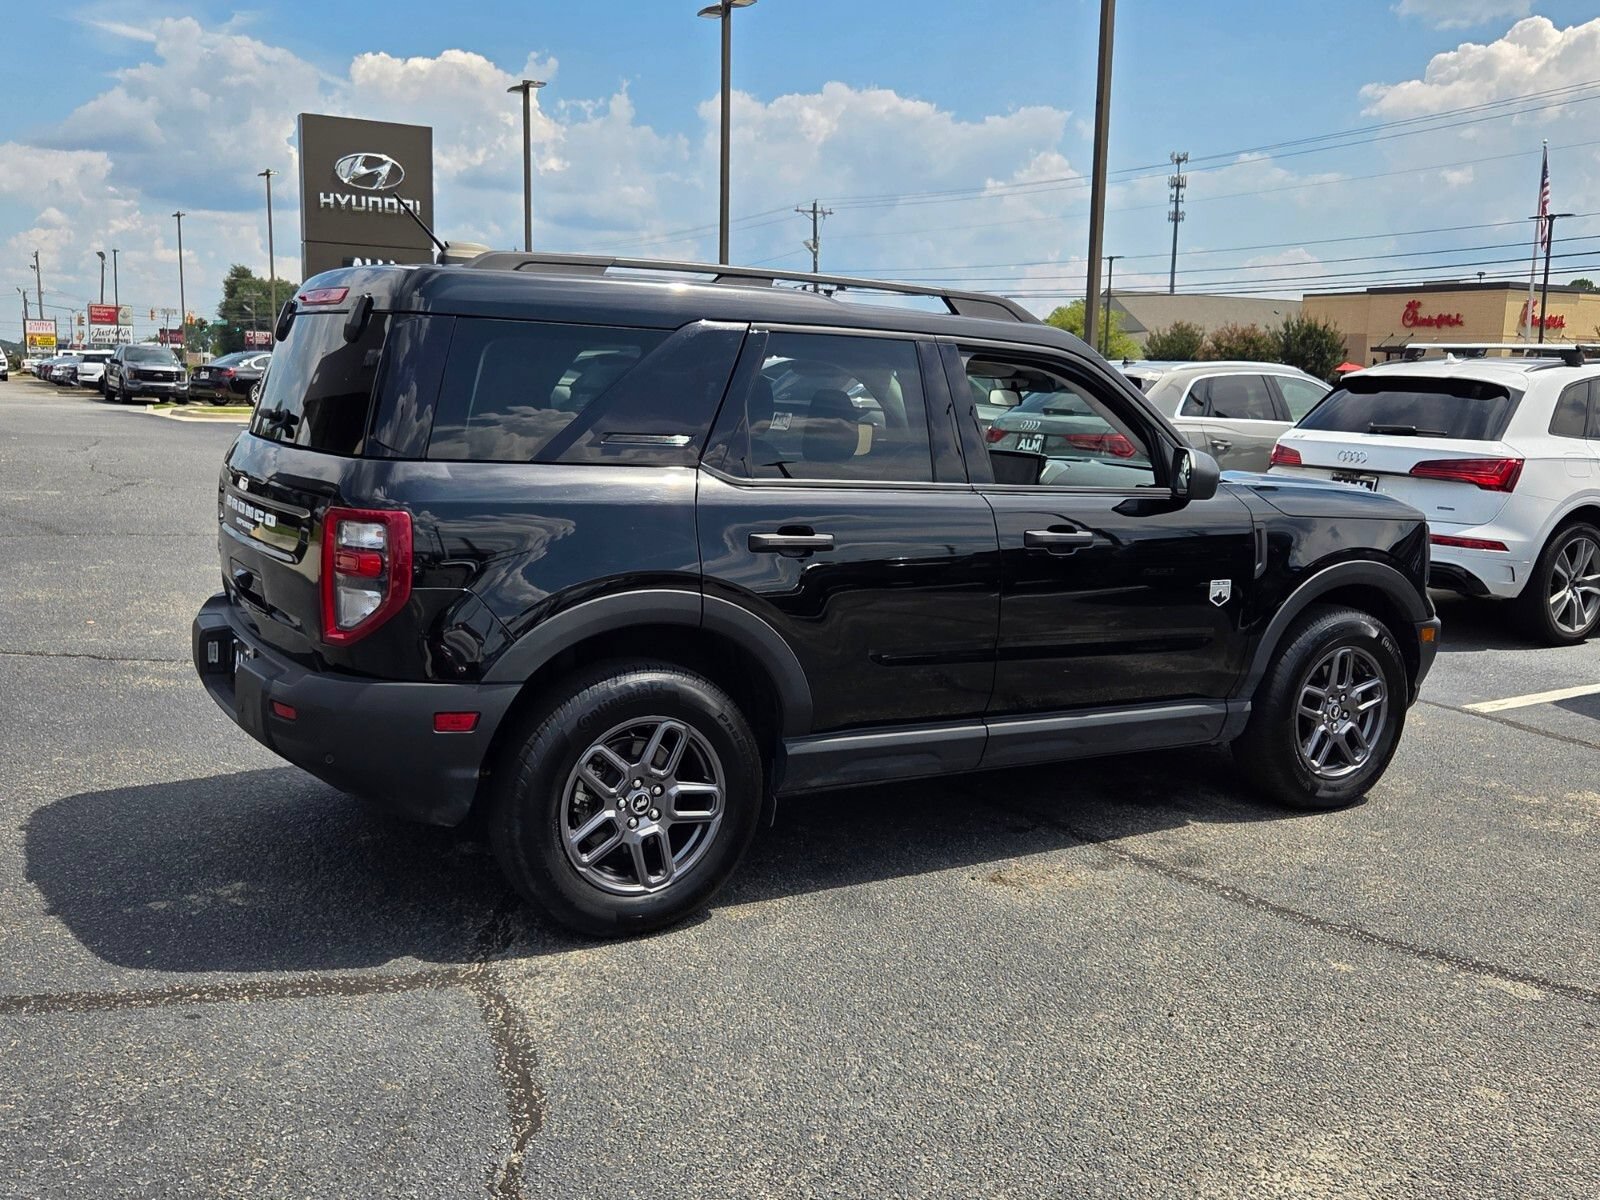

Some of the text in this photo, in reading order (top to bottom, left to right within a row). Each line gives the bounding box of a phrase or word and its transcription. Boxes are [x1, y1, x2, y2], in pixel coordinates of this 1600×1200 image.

[319, 192, 420, 215] HYUNDAI
[1017, 438, 1041, 451] ALM
[226, 494, 277, 528] BRONCO
